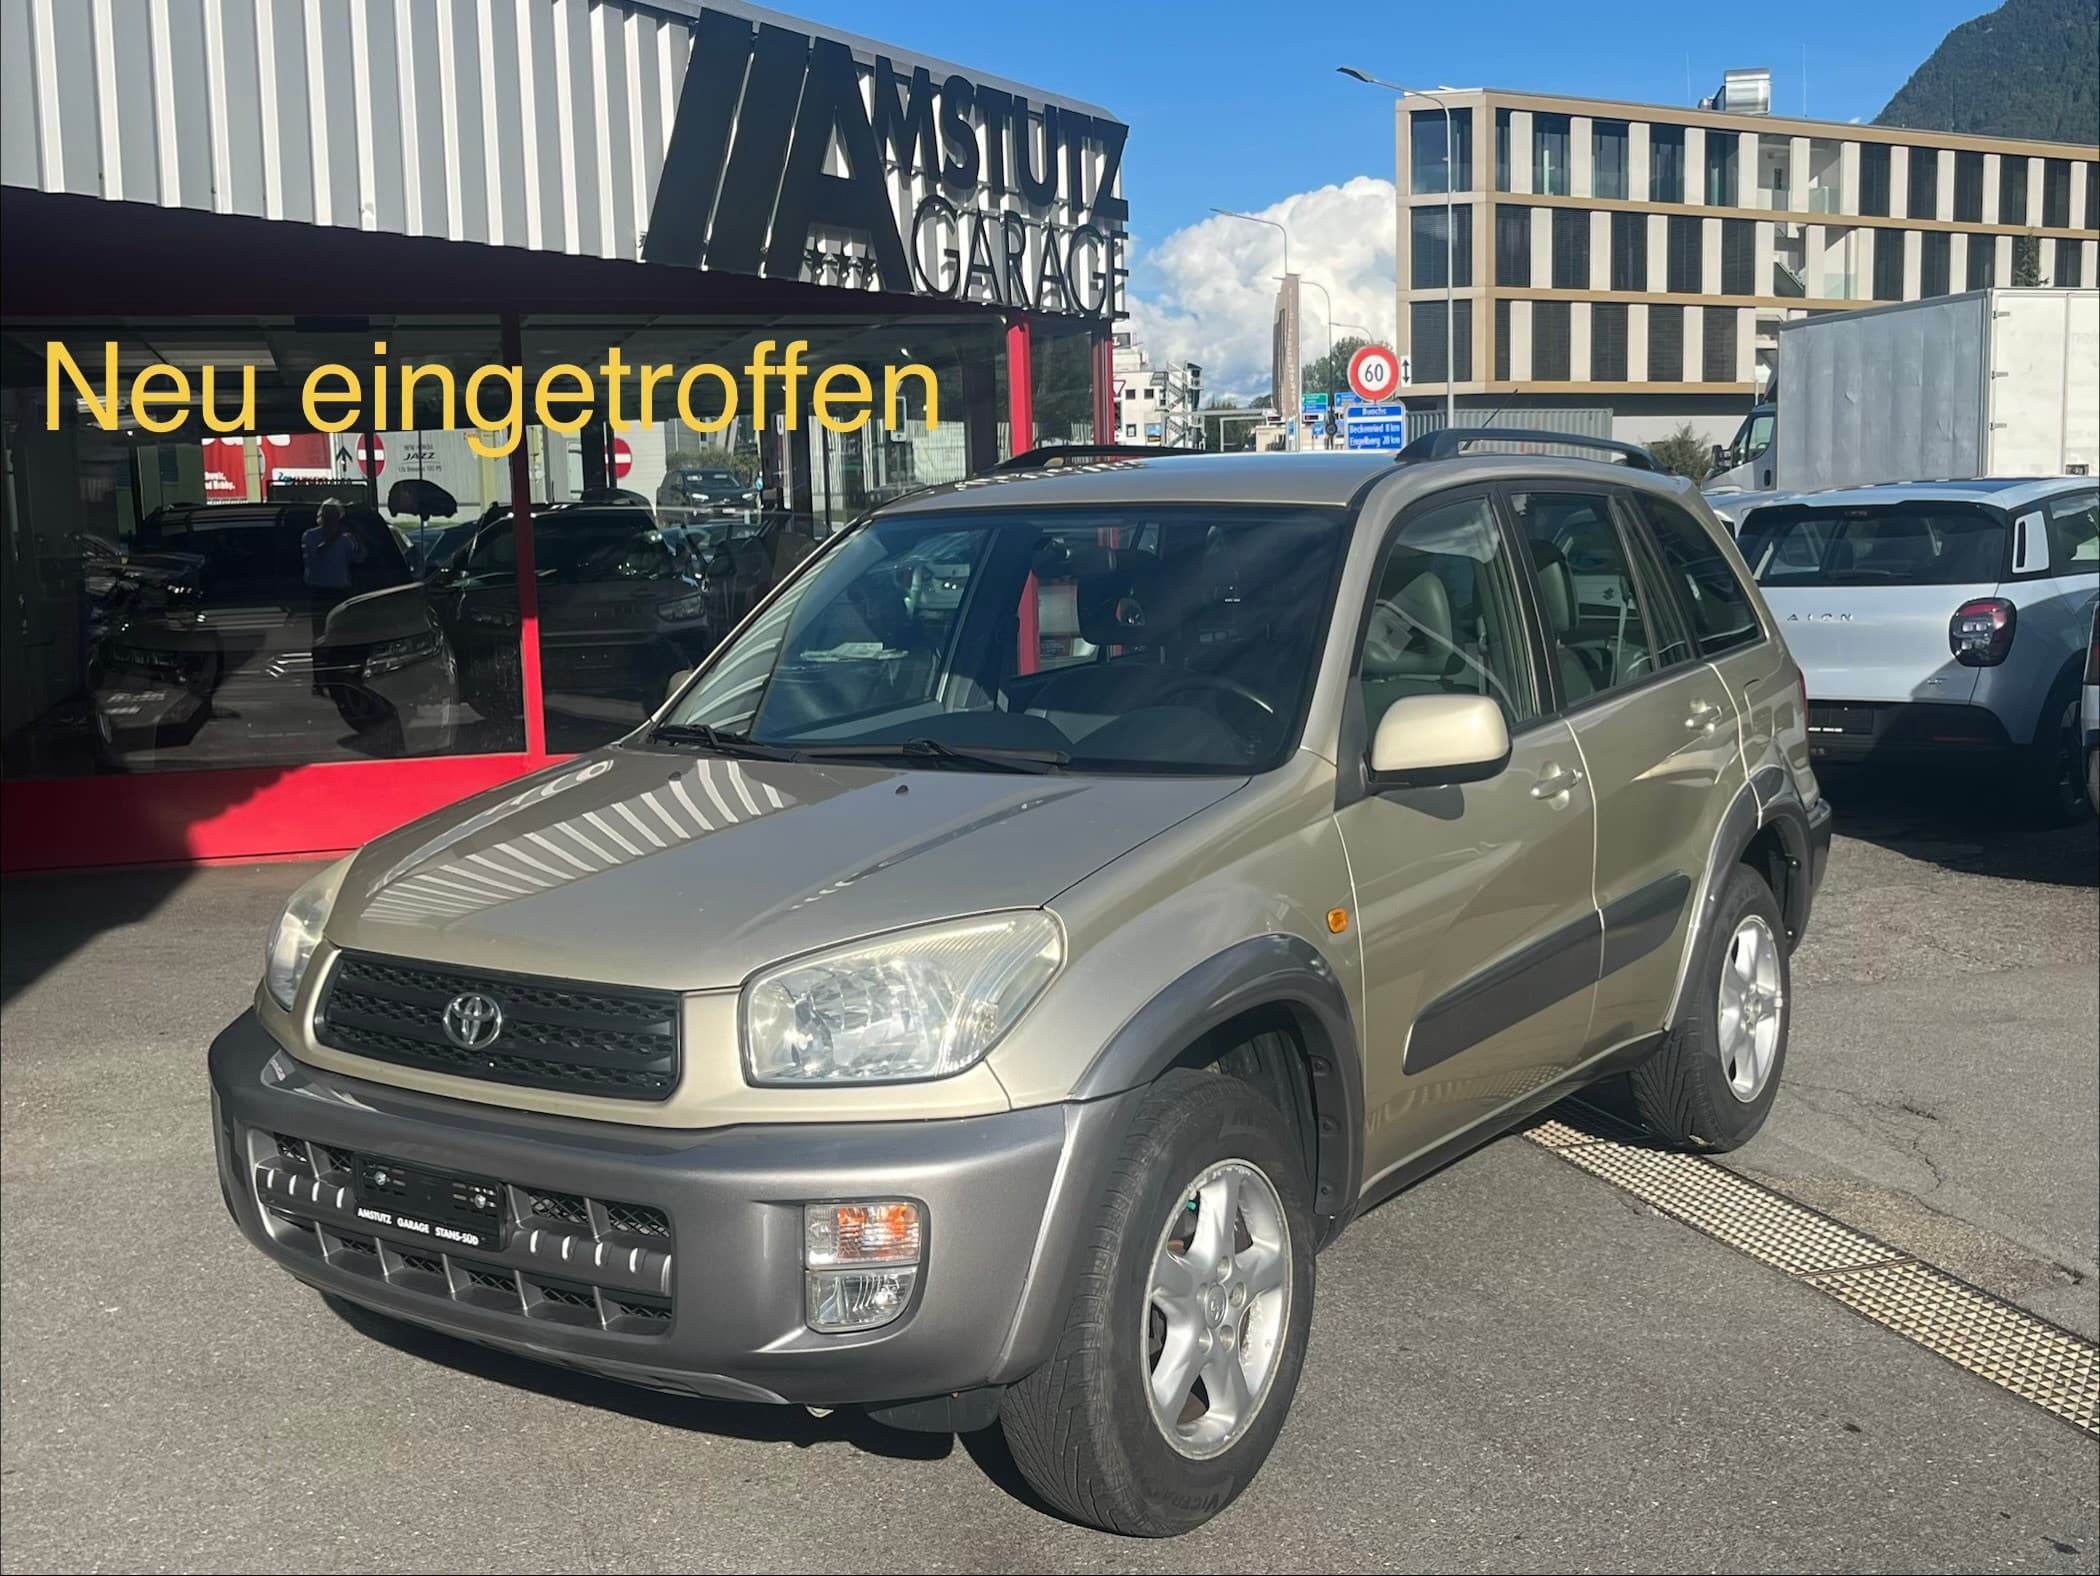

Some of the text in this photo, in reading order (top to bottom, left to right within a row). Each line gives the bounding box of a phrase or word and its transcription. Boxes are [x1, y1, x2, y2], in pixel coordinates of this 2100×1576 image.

[764, 36, 1129, 294] AMSTUTZ
[911, 194, 1129, 320] GARAGE
[1365, 364, 1384, 382] 60
[403, 452, 435, 461] JAZZ
[357, 1207, 480, 1246] AMSTUTZ GARAGE STANS-SÜD
